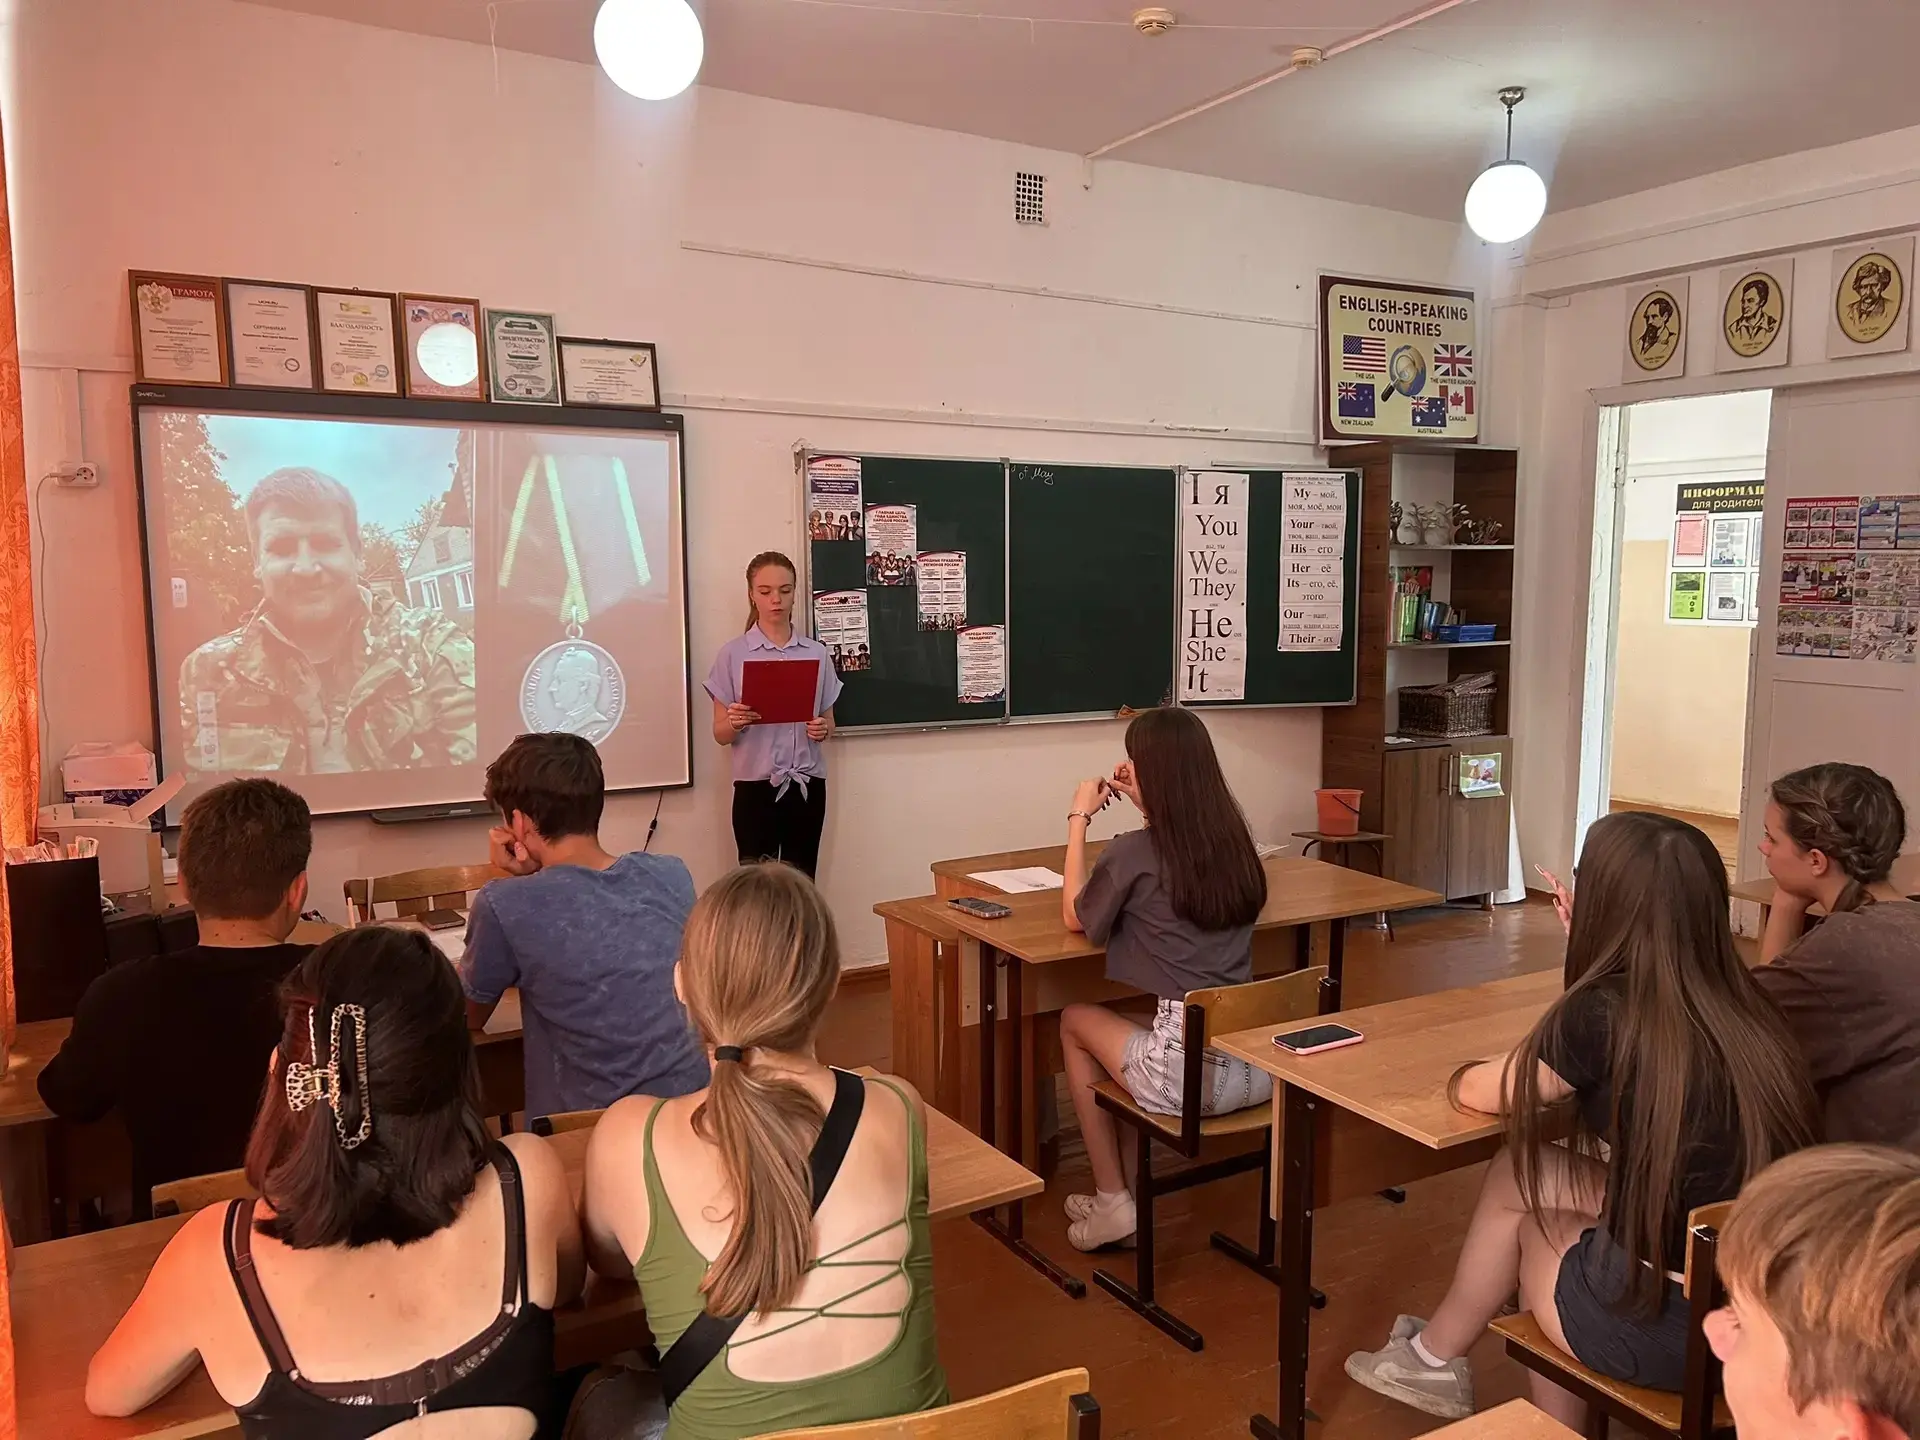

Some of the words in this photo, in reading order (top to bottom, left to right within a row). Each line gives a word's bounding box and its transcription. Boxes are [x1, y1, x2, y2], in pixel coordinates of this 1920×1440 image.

[173, 288, 215, 298] ГРАМОТА
[1339, 295, 1468, 321] ENGLISH-SPEAKING
[1368, 317, 1442, 337] COUNTRIES
[1189, 473, 1202, 505] I
[1293, 487, 1311, 500] My
[1692, 500, 1711, 510] для
[1195, 514, 1239, 536] You
[1290, 519, 1315, 529] Your
[1290, 544, 1307, 554] His
[1317, 546, 1334, 554] его
[1188, 550, 1228, 575] We
[1292, 563, 1311, 573] Her
[1189, 577, 1236, 601] They
[1286, 578, 1300, 588] Its
[1302, 593, 1324, 601] этого
[1283, 609, 1305, 619] Our
[1188, 608, 1233, 638] He
[1288, 633, 1317, 644] Their
[1186, 640, 1227, 662] She
[1186, 664, 1209, 693] It
